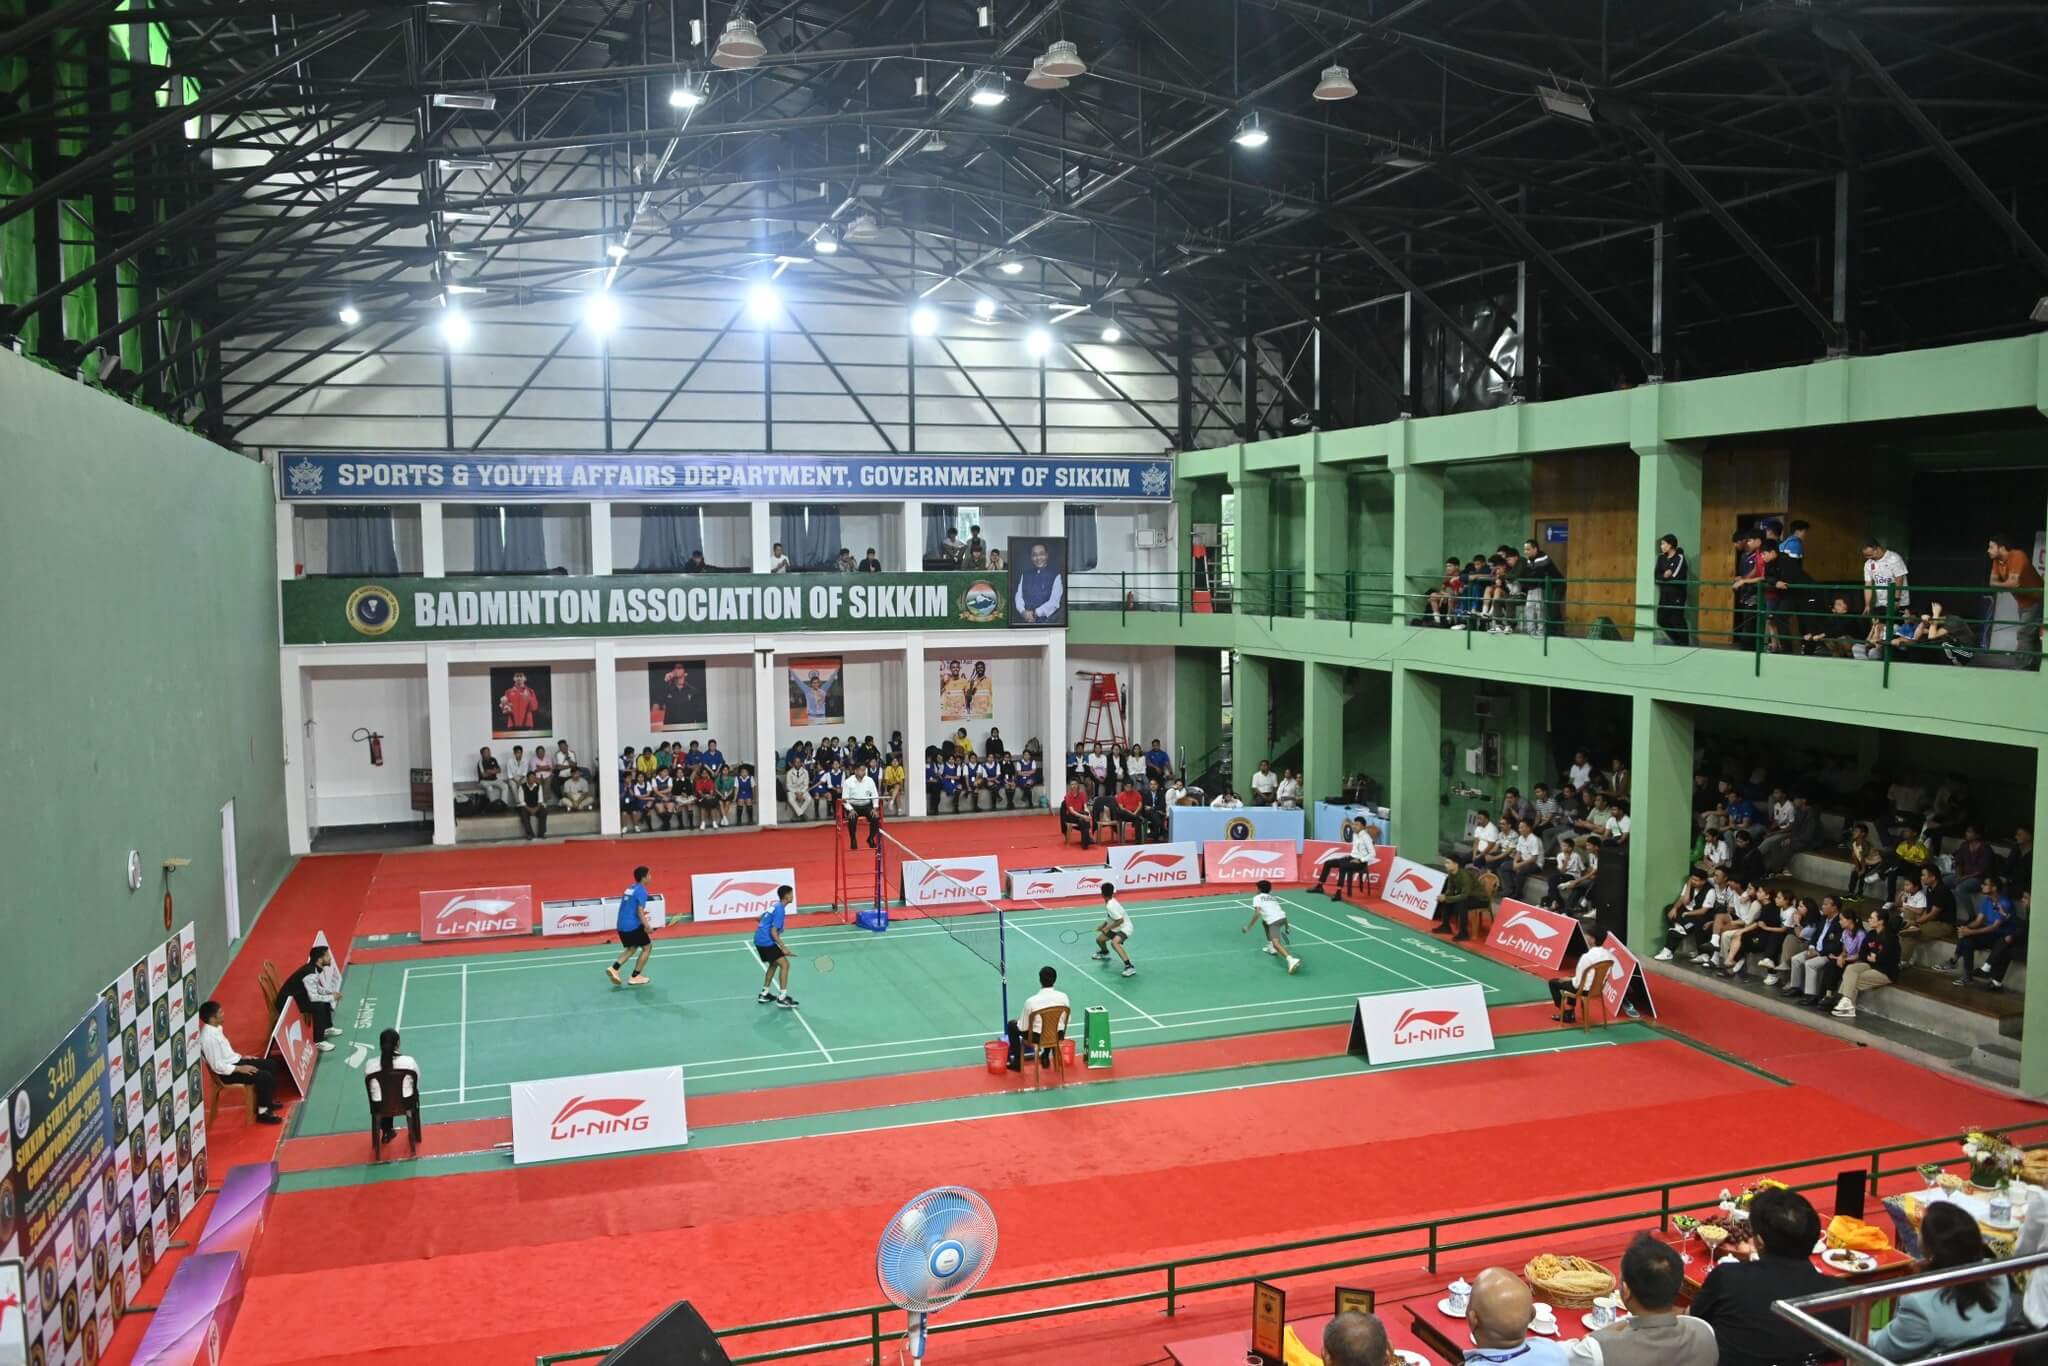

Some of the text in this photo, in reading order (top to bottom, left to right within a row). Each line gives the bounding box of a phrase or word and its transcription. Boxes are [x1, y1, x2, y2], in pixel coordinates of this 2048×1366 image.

[338, 464, 444, 486] SPORTS
[452, 464, 469, 486] &
[476, 464, 563, 486] YOUTH
[571, 464, 676, 486] AFFAIRS
[860, 465, 1015, 487] GOVERNMENT
[1021, 466, 1049, 487] OF
[1055, 467, 1130, 487] SIKKIM
[414, 588, 601, 627] BADMINTON
[607, 585, 802, 624] ASSOCIATION
[809, 585, 843, 619] OF
[848, 584, 948, 619] SIKKIM
[1124, 870, 1188, 884] LI-NING
[1218, 867, 1286, 879] LI-NING
[1390, 887, 1429, 911] LI-NING
[436, 918, 518, 935] LI-NING
[1496, 931, 1553, 961] LI-NING
[1098, 1039, 1106, 1048] 2
[1394, 1025, 1465, 1046] LI-NING
[1090, 1050, 1112, 1059] MIN.
[47, 1045, 76, 1100] 34th
[15, 1120, 46, 1173] SIKKIM
[45, 1096, 68, 1138] STATE
[551, 1116, 649, 1140] LI-NING
